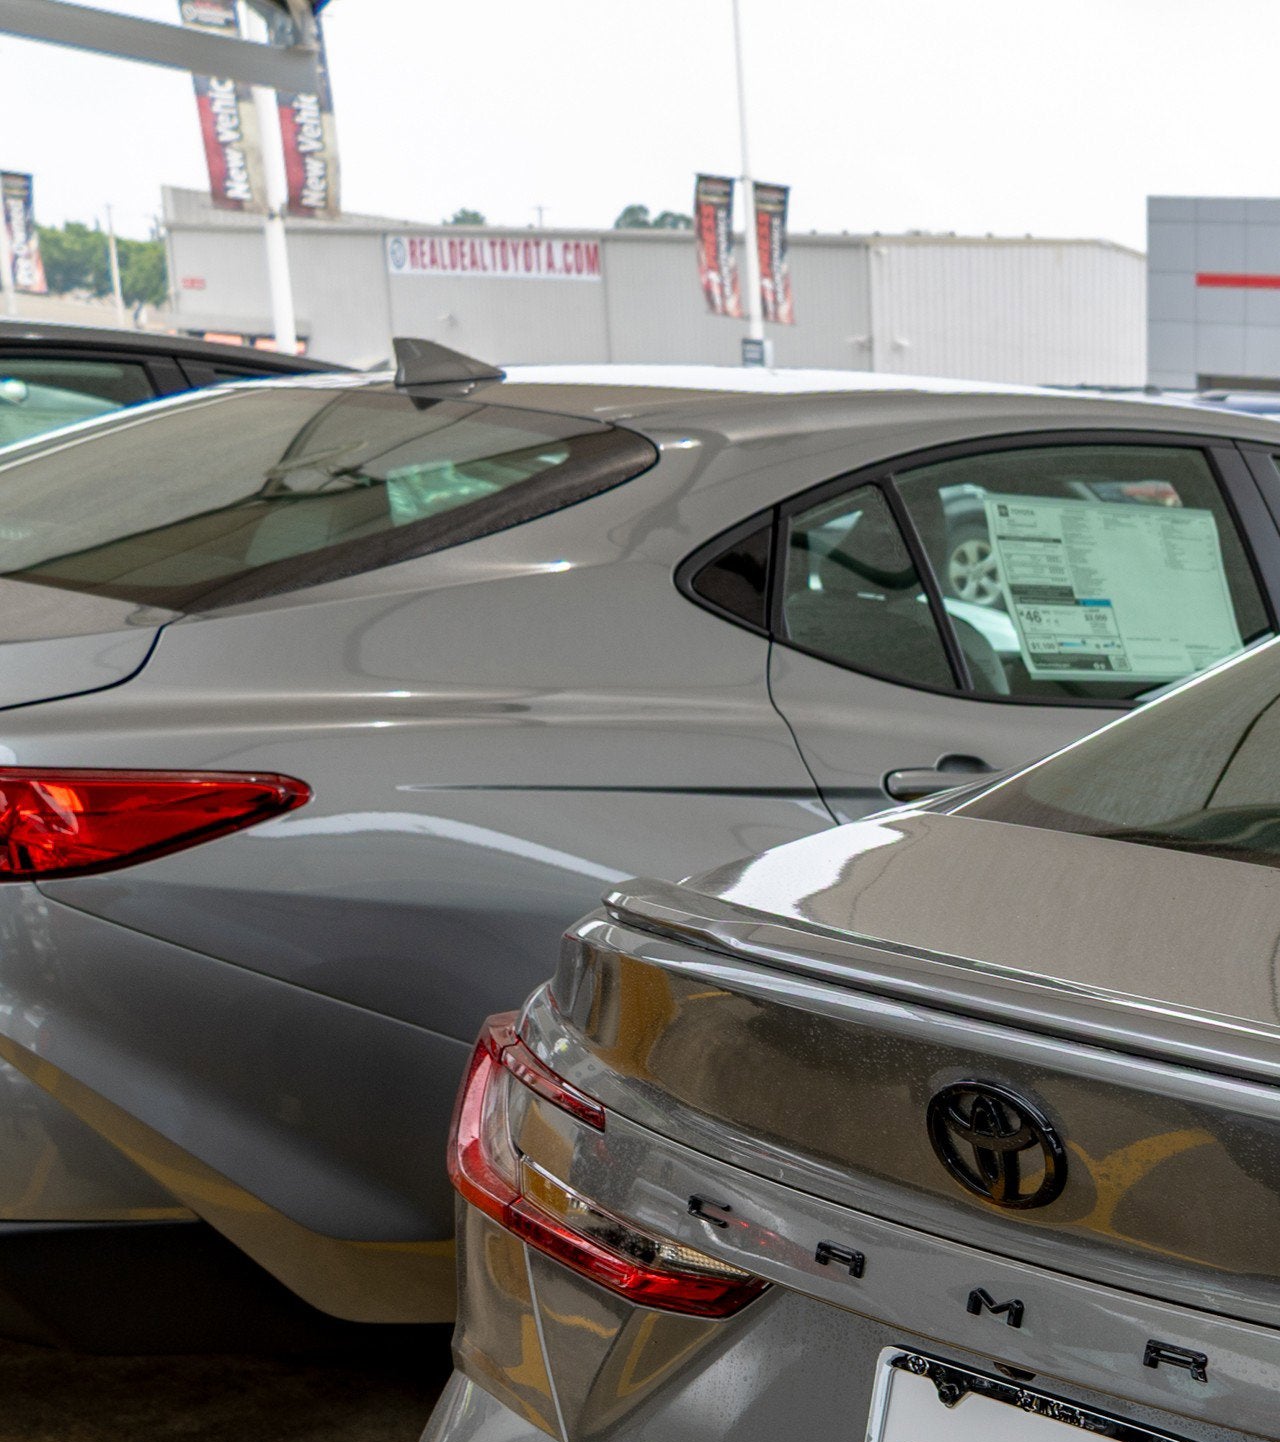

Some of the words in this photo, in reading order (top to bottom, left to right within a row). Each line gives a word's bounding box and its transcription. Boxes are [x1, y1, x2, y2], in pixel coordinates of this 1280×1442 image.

[223, 147, 252, 200] New
[301, 156, 327, 208] New
[409, 238, 600, 276] REALDEALTOYOTA.COM
